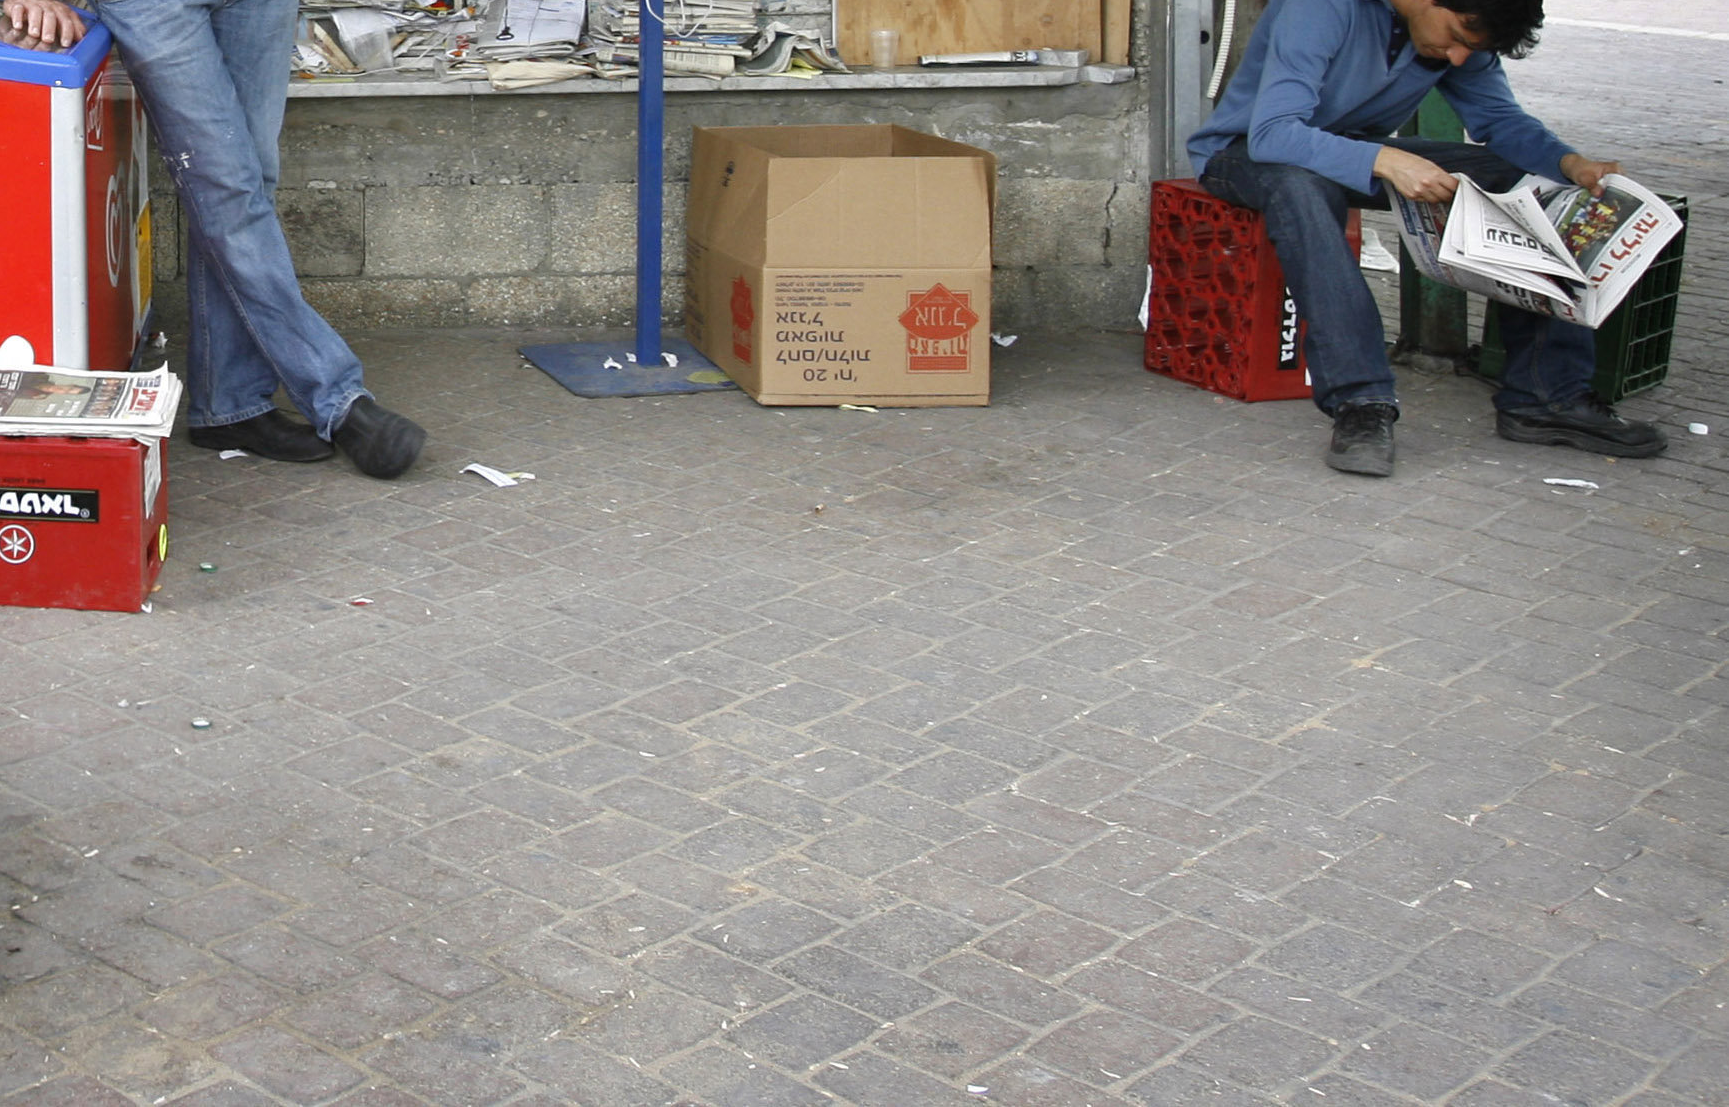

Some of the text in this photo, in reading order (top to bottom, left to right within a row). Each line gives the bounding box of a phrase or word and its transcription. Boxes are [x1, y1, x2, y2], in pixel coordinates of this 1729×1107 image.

[776, 311, 824, 326] אנג'ל
[775, 330, 845, 344] מאפיות
[775, 348, 871, 364] לחם/חלות
[803, 368, 827, 381] 20
